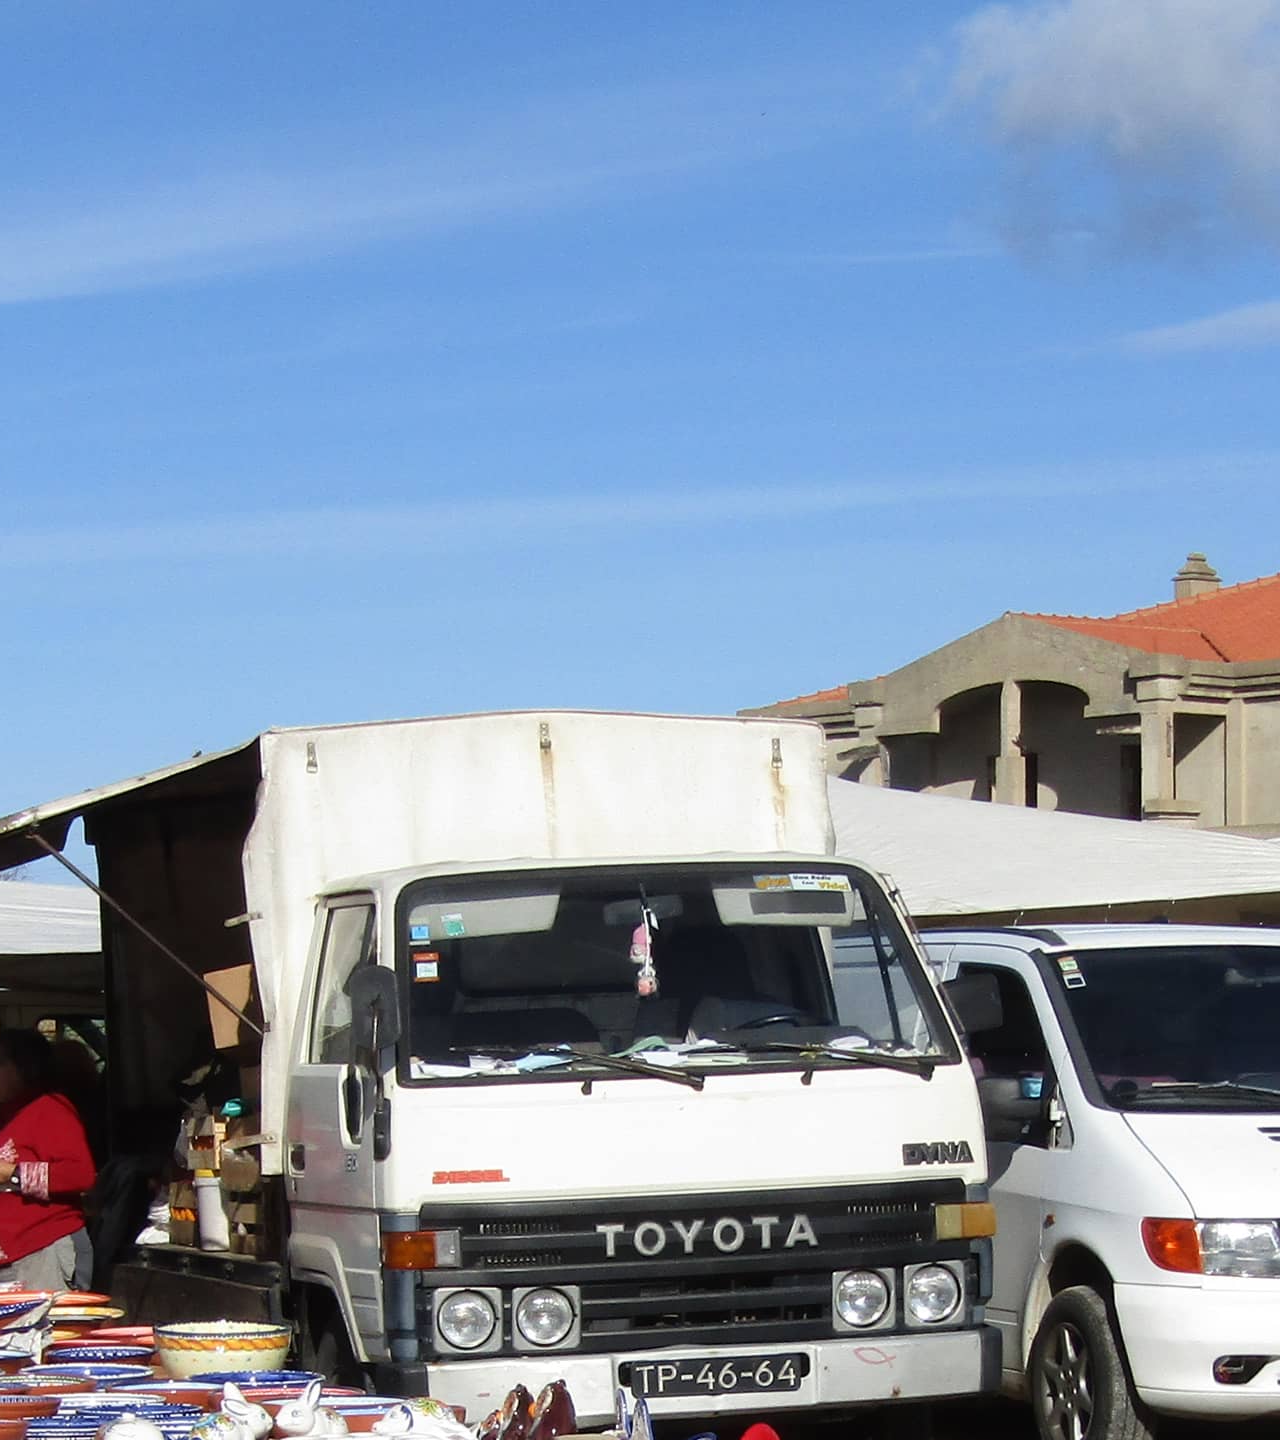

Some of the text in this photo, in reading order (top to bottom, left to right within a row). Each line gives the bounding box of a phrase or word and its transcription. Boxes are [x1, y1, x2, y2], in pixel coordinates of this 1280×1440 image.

[902, 1141, 974, 1165] DYNA
[432, 1169, 510, 1184] DIESEL
[595, 1214, 819, 1257] TOYOTA
[635, 1359, 797, 1394] TP-46-64
